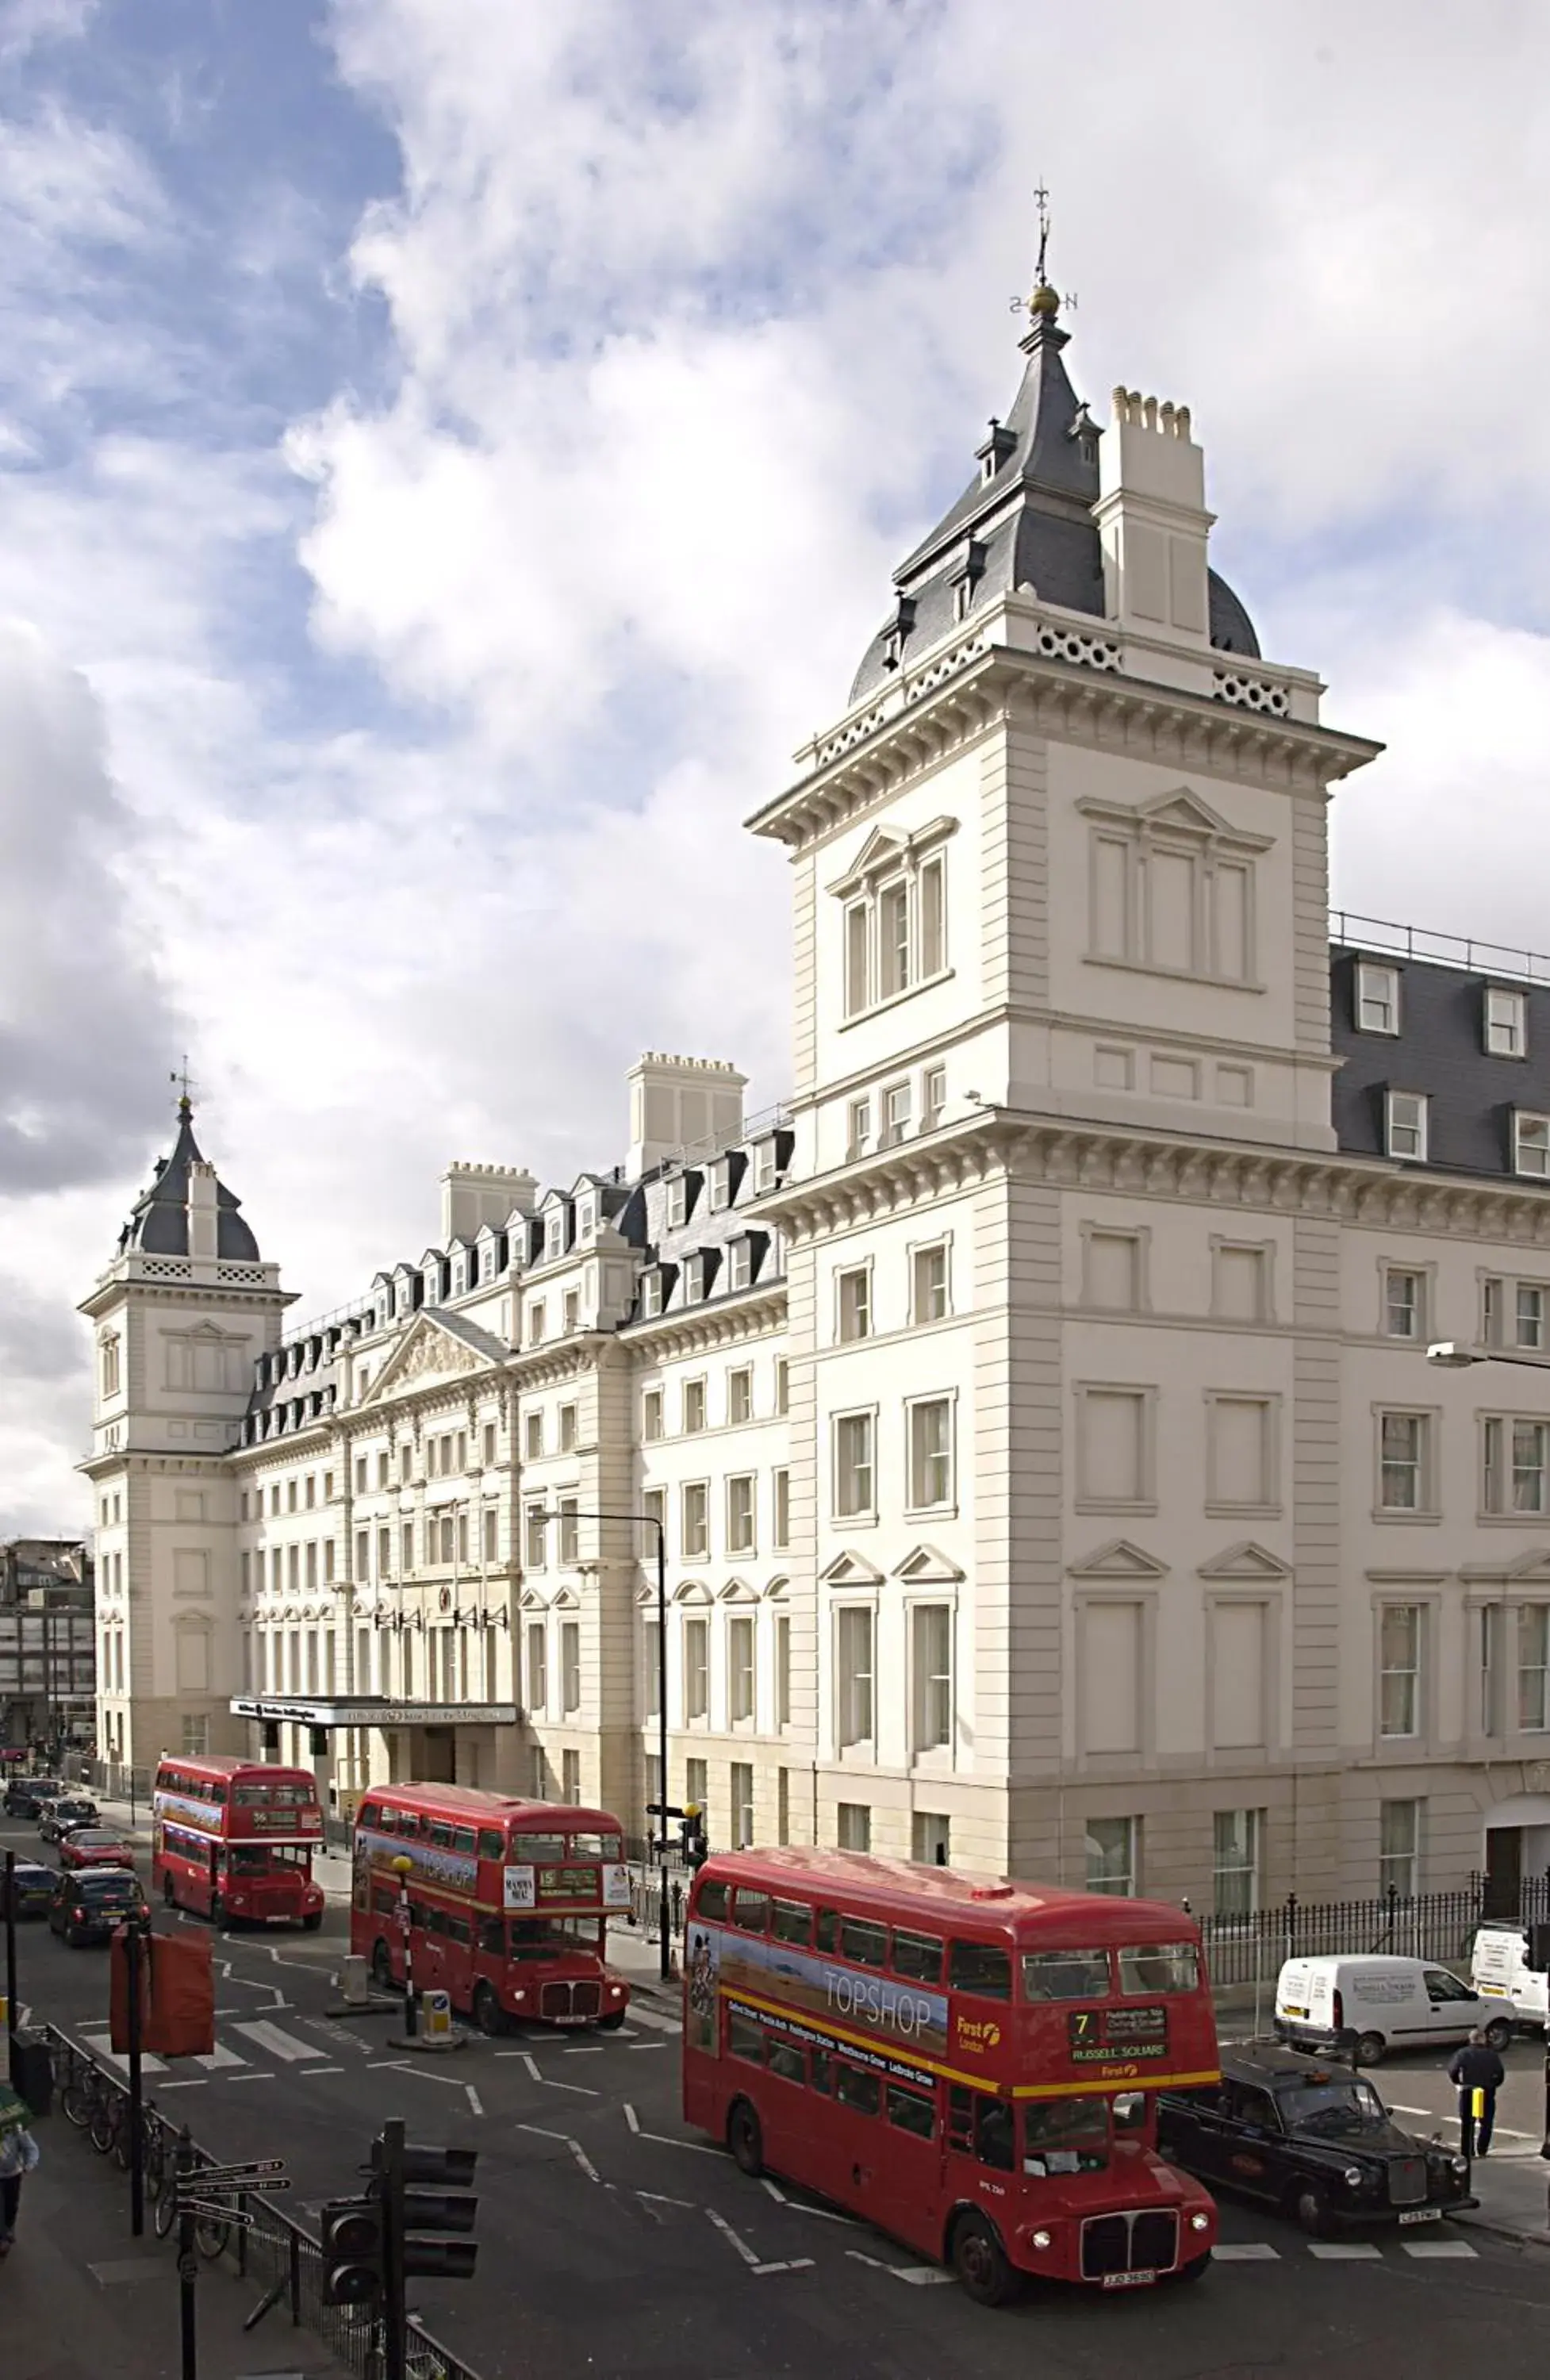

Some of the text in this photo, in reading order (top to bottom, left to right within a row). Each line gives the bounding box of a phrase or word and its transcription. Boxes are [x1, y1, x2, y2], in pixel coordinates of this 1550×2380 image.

[824, 1971, 930, 2038] TOPSHOP
[957, 2016, 983, 2038] First
[1076, 2014, 1089, 2034] 7
[958, 2035, 984, 2054] London
[1072, 2044, 1165, 2060] RUSSELL SQUARE
[1101, 2065, 1124, 2077] First
